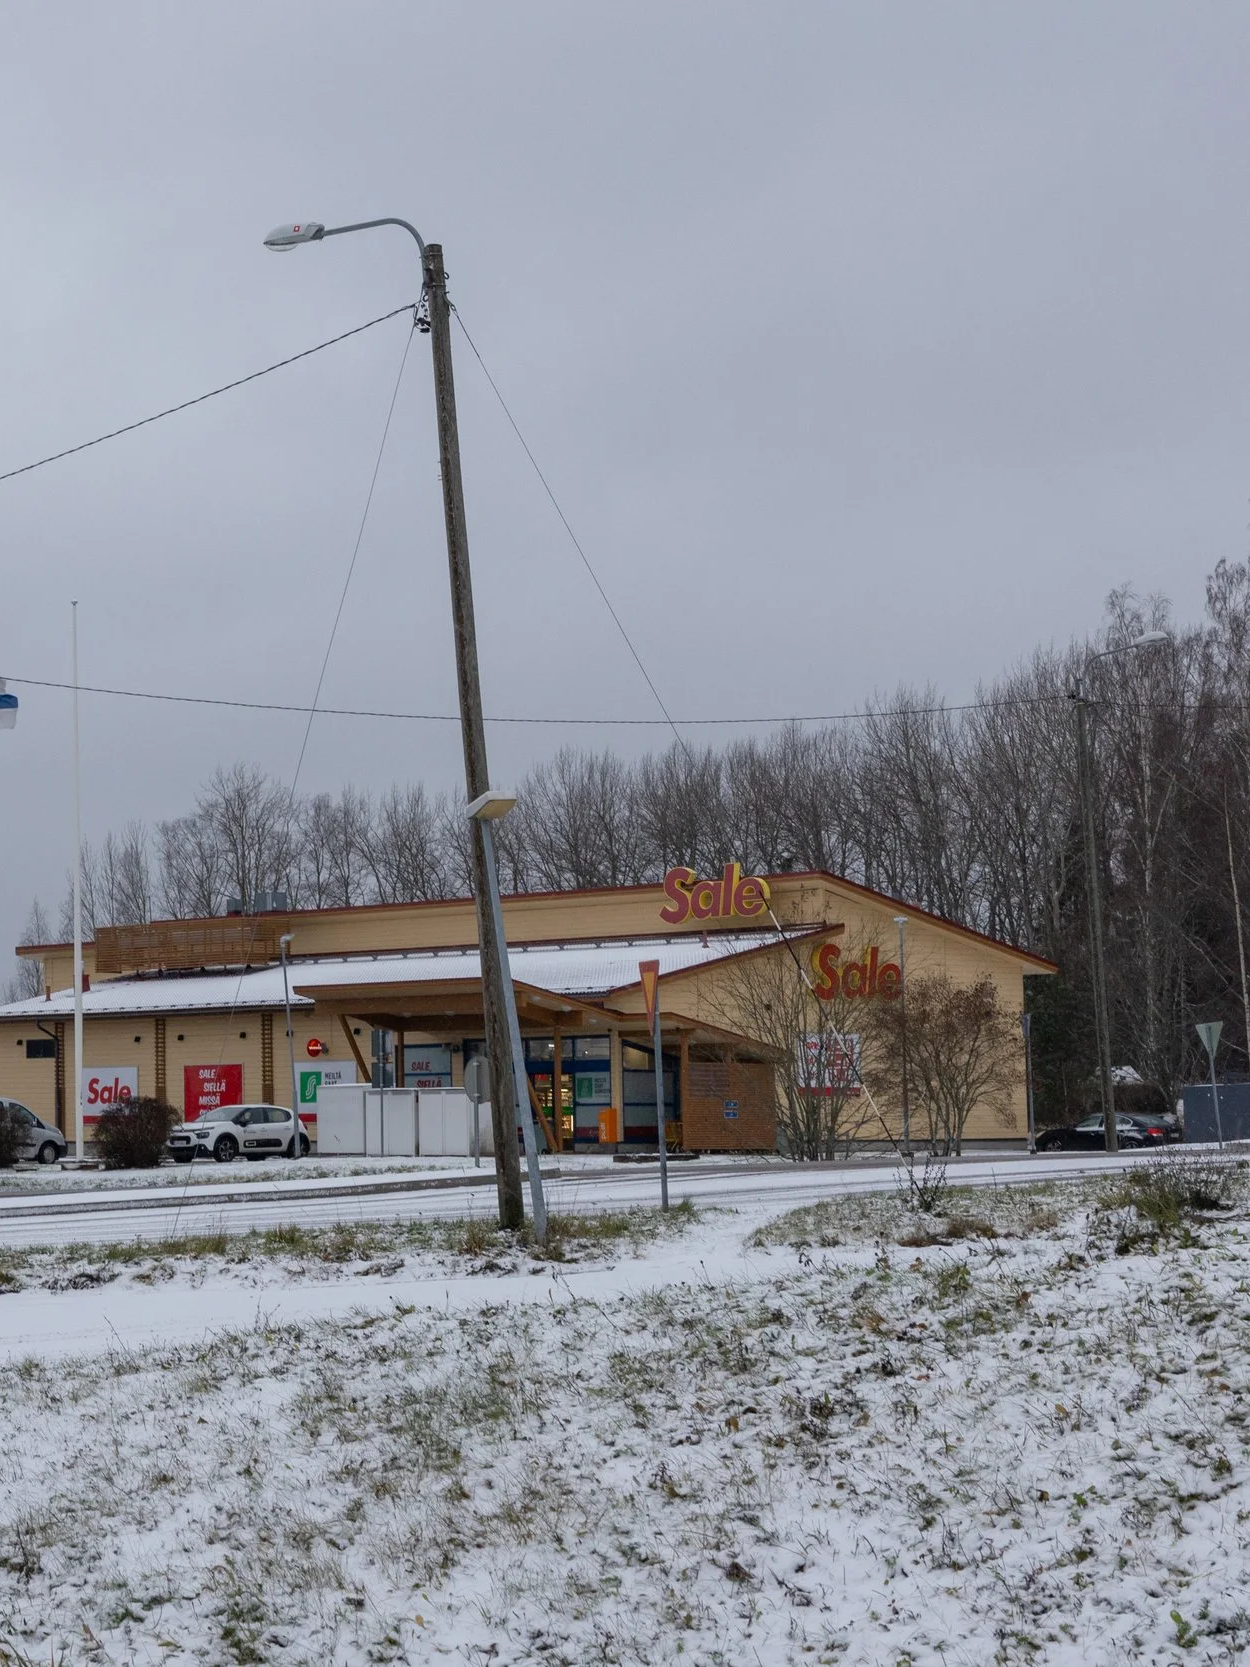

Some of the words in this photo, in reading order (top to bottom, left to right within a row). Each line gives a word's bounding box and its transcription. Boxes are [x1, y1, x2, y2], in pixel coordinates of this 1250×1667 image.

[659, 863, 771, 925] Sale
[812, 943, 902, 1000] Sale
[87, 1077, 131, 1105] Sale
[199, 1093, 220, 1106] MISSÄ
[203, 1080, 226, 1092] SIELLÄ
